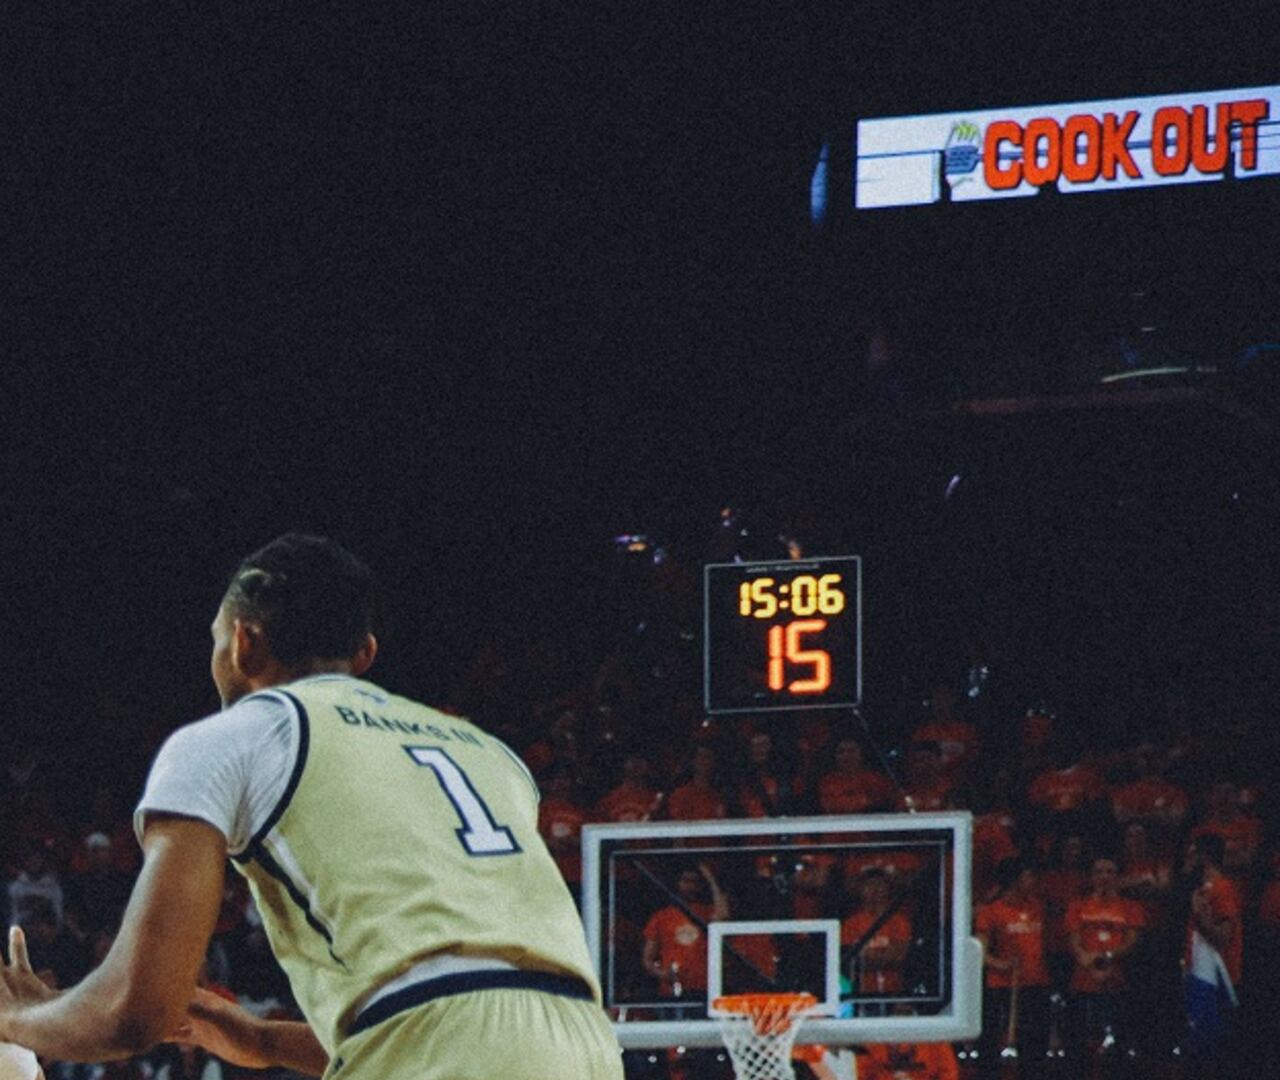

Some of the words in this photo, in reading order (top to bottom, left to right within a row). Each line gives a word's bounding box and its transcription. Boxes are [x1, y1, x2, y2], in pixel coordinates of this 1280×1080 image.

[982, 110, 1143, 190] COOK
[1151, 99, 1269, 175] OUT
[740, 574, 845, 619] 15:06
[768, 619, 831, 693] 15
[335, 706, 452, 741] BANKS
[401, 745, 523, 858] 1
